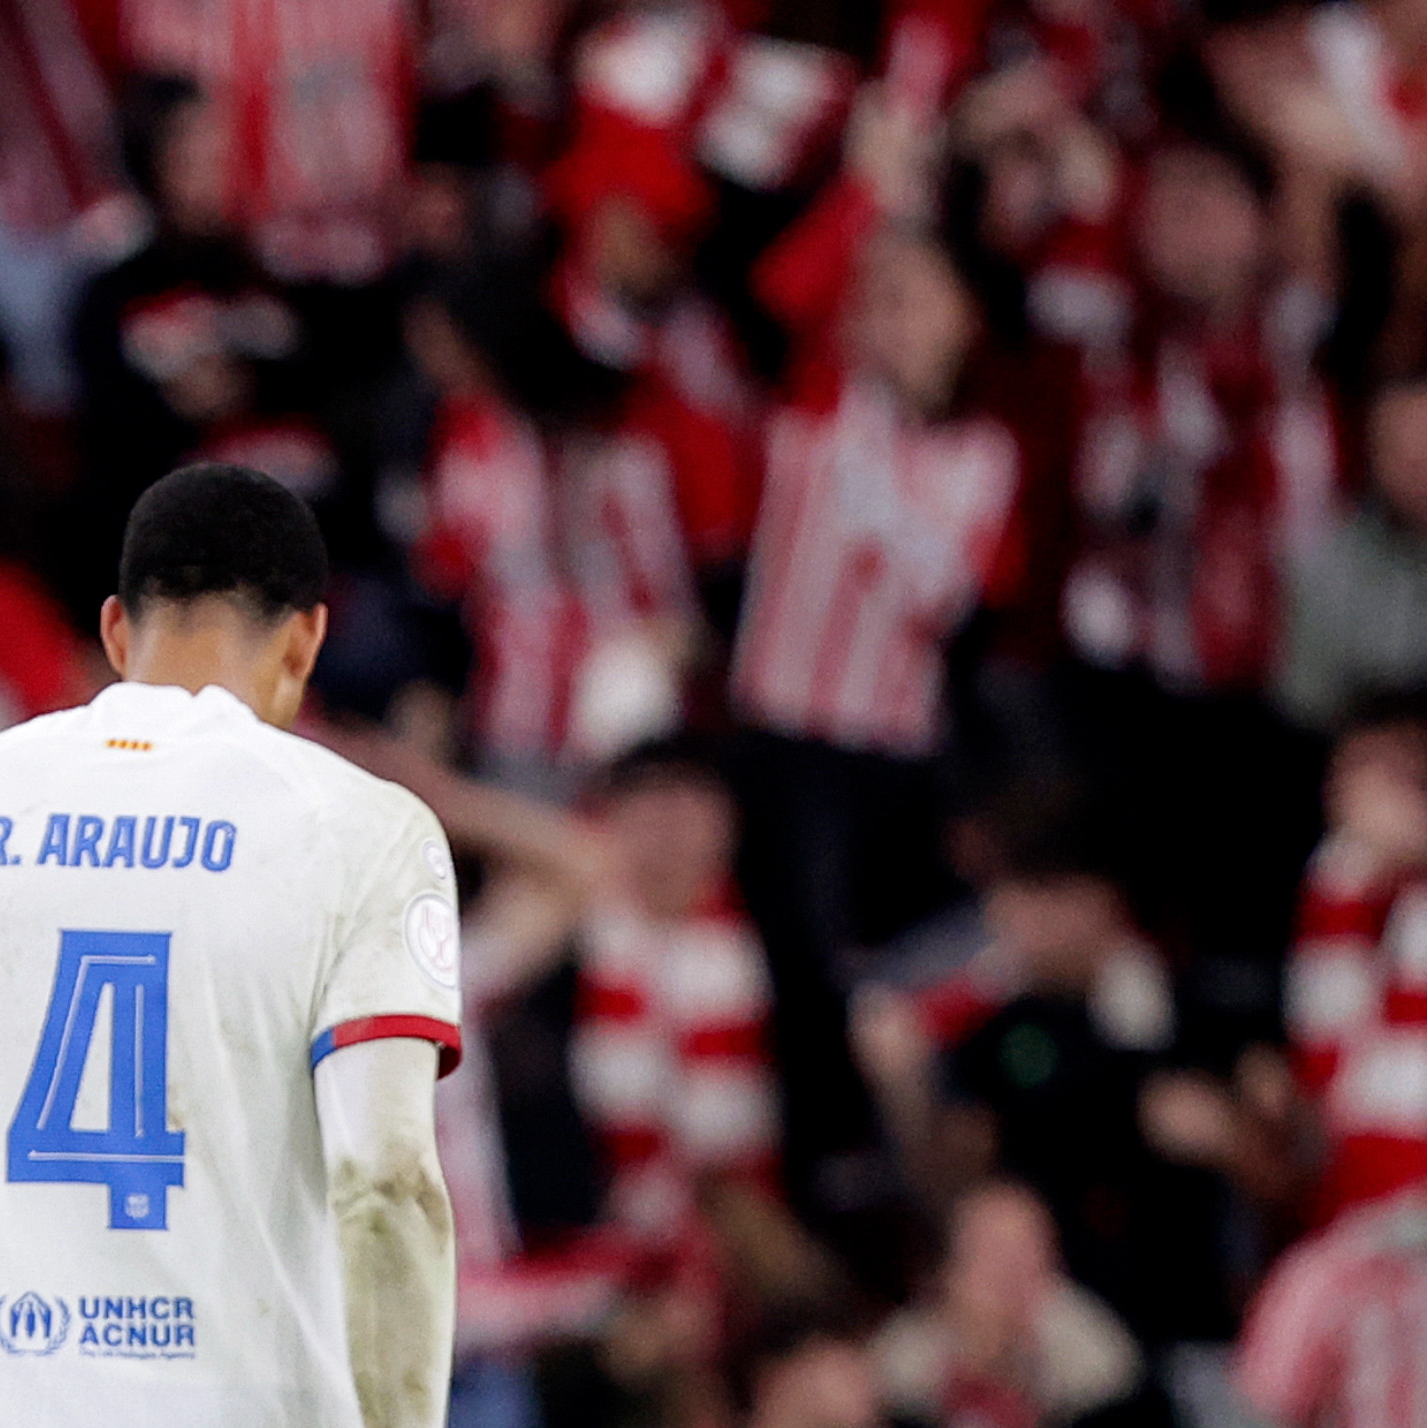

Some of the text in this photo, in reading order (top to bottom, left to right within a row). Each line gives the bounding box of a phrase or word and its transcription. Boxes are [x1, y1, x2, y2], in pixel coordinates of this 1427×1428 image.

[36, 813, 238, 872] ARAUJO
[6, 930, 185, 1230] 4
[79, 1296, 195, 1319] UNHCR
[79, 1322, 195, 1347] ACNUR
